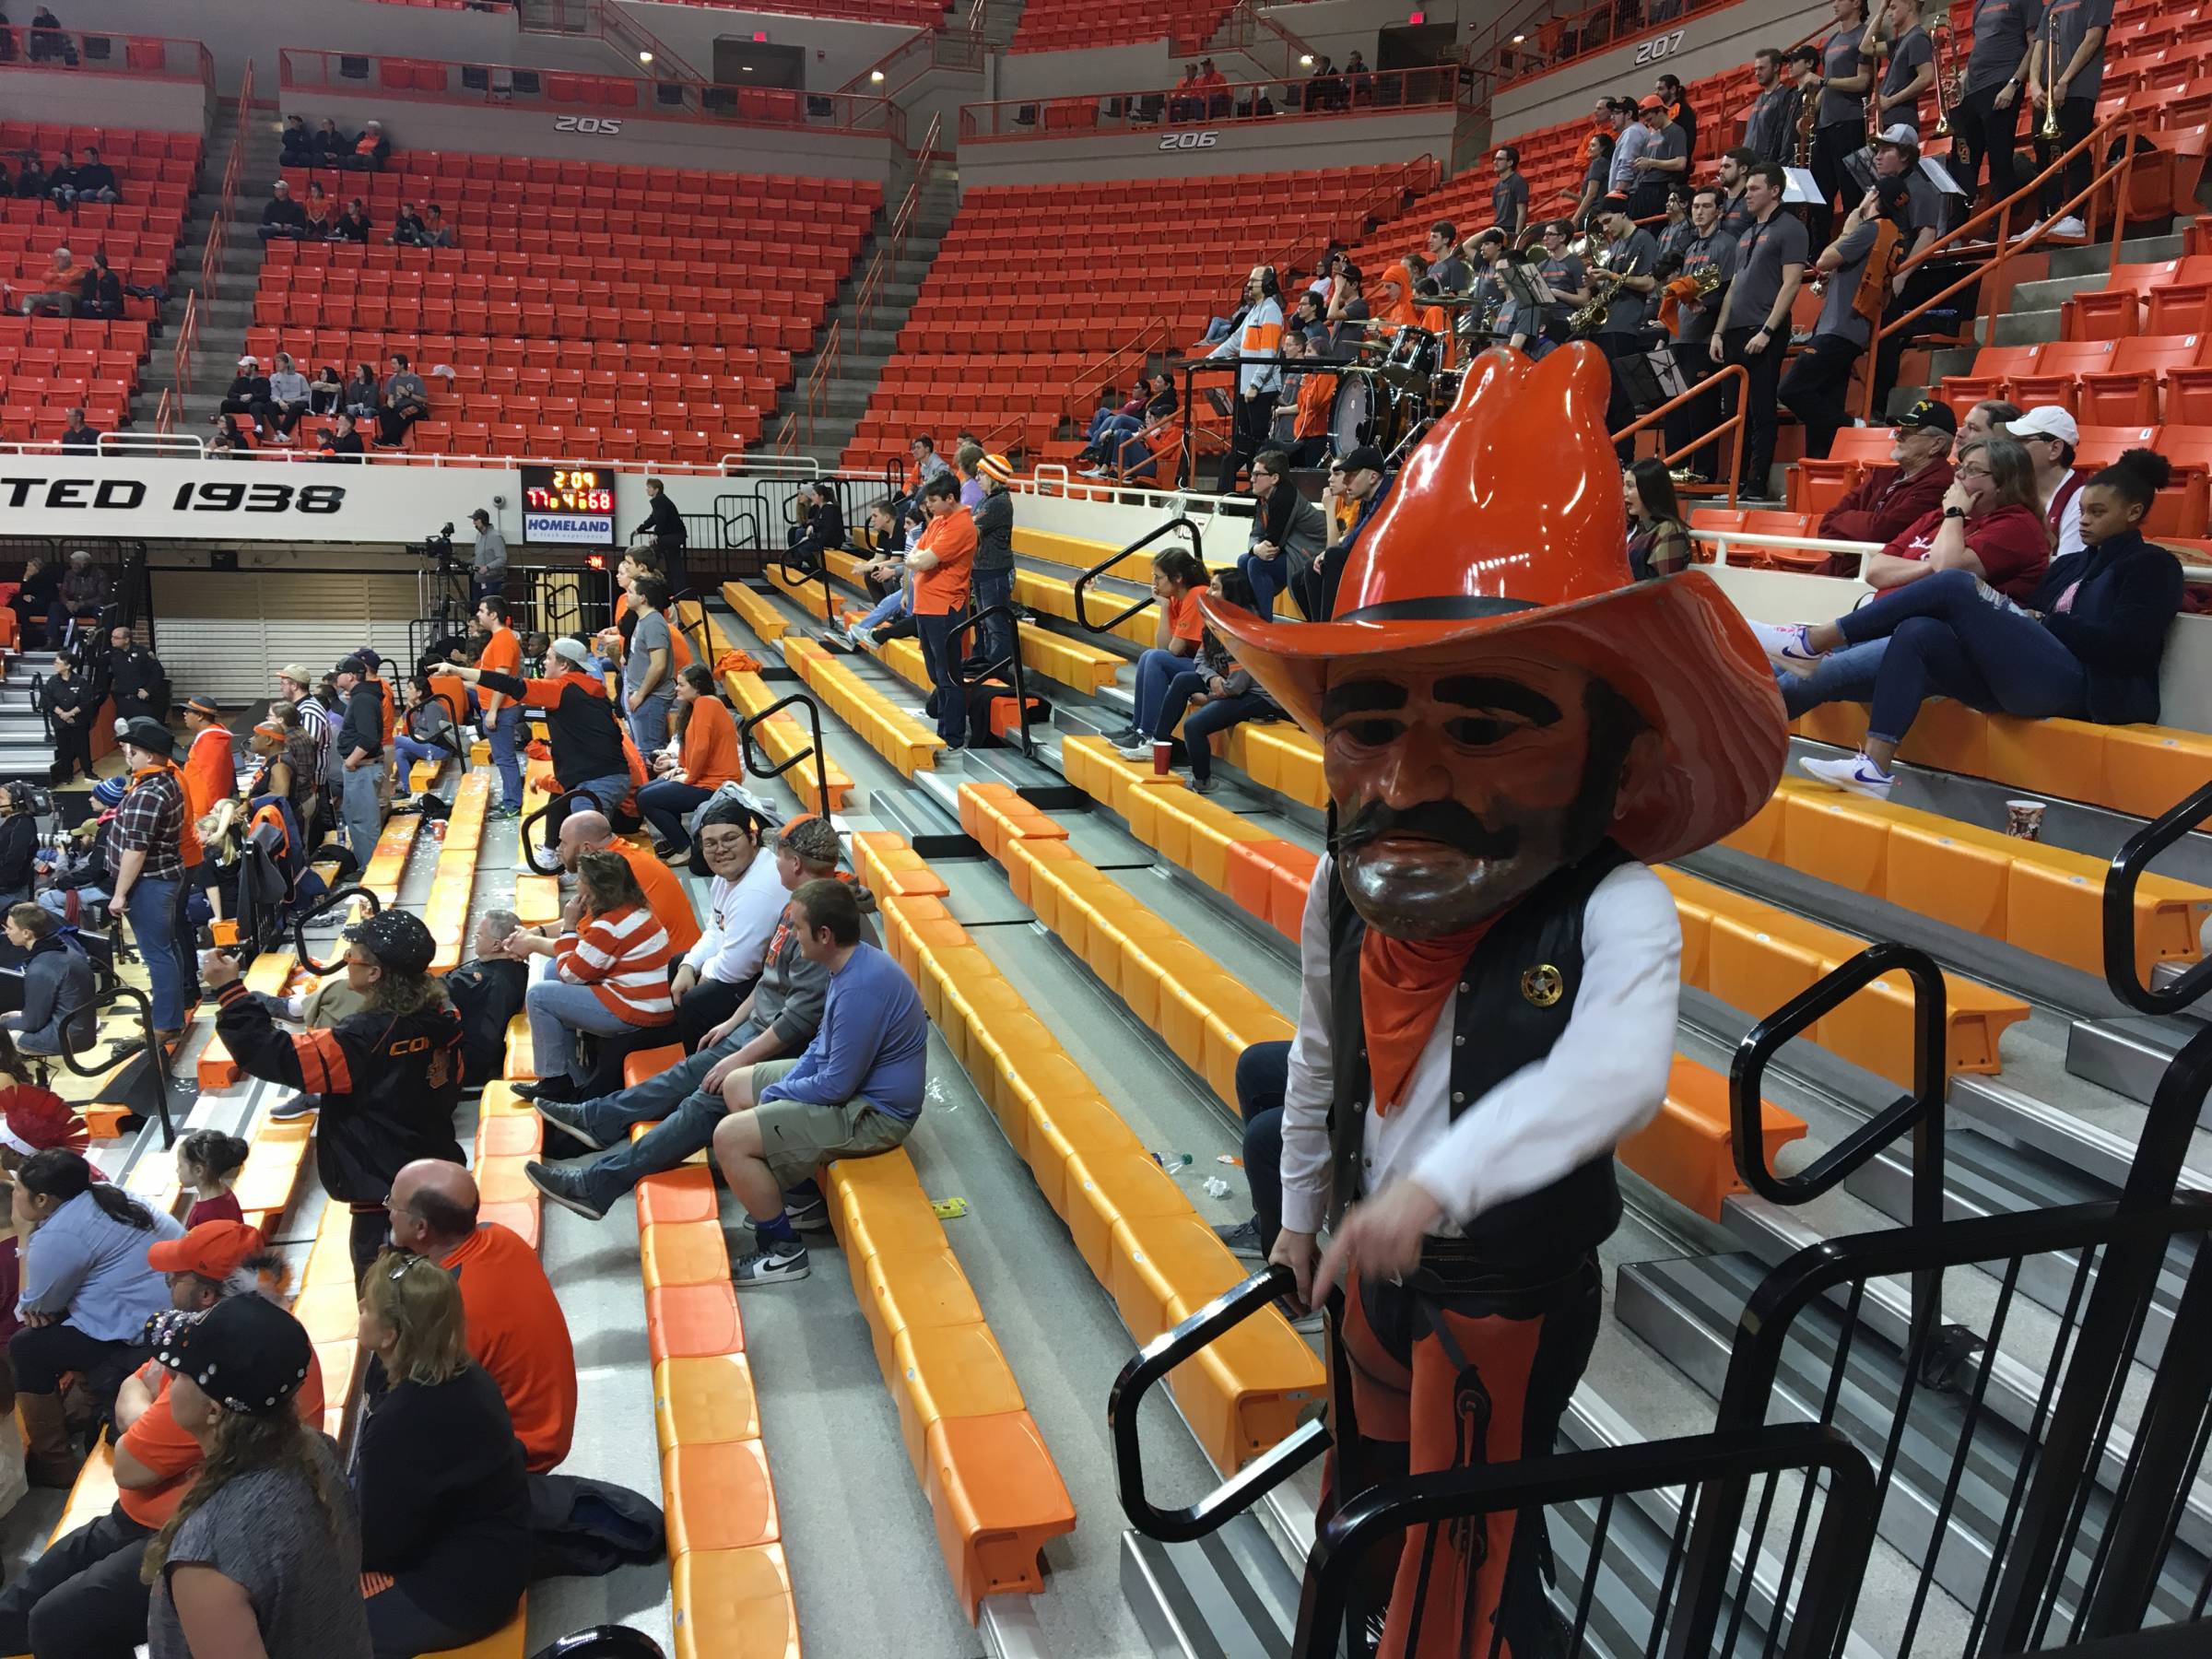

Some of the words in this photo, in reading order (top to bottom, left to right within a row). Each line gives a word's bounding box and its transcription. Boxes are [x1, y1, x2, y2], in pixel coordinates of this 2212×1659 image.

[1634, 29, 1686, 65] 207
[554, 115, 623, 135] 205
[1159, 131, 1219, 150] 206
[553, 471, 594, 488] 2:09
[0, 477, 147, 509] TED
[172, 482, 347, 513] 1938
[527, 491, 548, 508] 77
[562, 493, 574, 508] 4
[588, 494, 610, 509] 68
[528, 519, 610, 532] HOMELAND
